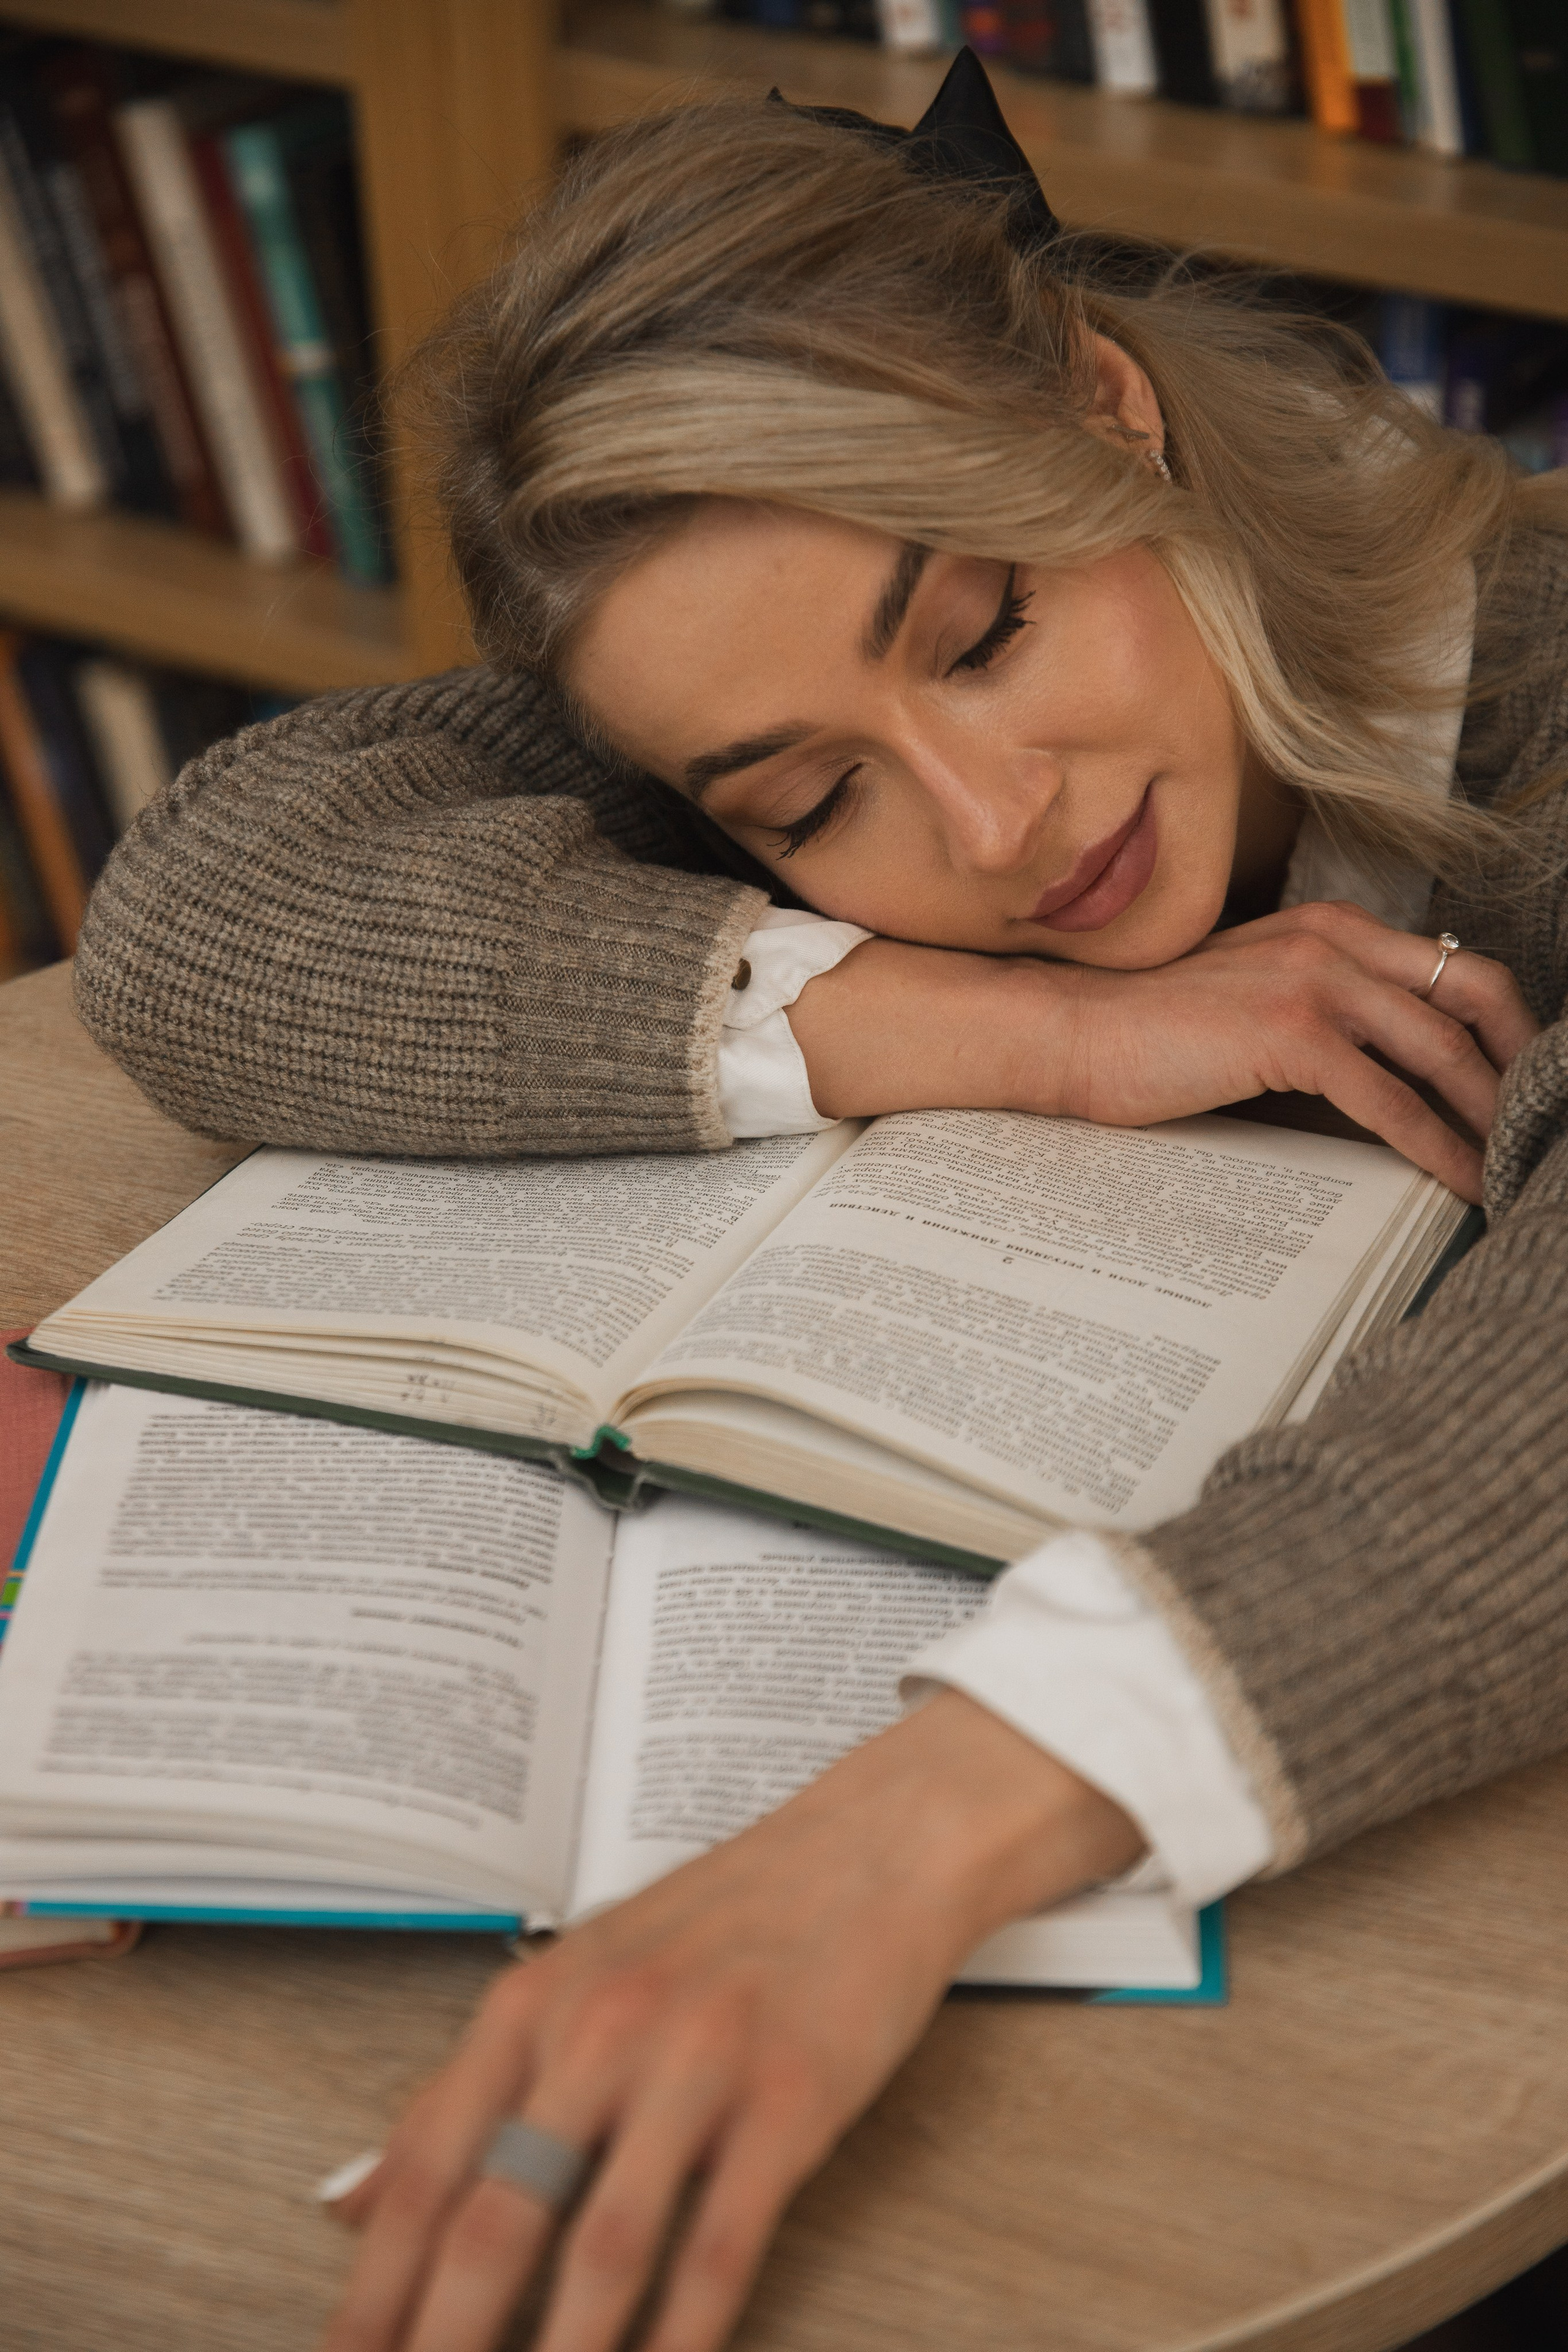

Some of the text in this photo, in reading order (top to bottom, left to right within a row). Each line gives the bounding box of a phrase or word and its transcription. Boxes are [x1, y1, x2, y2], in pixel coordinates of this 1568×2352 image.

[920, 1123, 973, 1139] синдром
[967, 1117, 1005, 1134] более
[1041, 1115, 1101, 1133] никакого
[979, 1139, 1007, 1150] этот
[1010, 1132, 1033, 1142] как
[1104, 1131, 1167, 1147] обращает
[940, 1138, 1029, 1168] описываемого
[1012, 1150, 1035, 1159] что
[1039, 1141, 1077, 1155] время
[1102, 1142, 1188, 1165] намерениями
[1194, 1148, 1214, 1158] бы,
[968, 1153, 1026, 1172] желаний
[1014, 1123, 1343, 1204] деть, наблюдая ориентировочные реакции таких
[1044, 1157, 1091, 1175] думать,
[1218, 1155, 1276, 1169] казалось
[903, 1114, 1323, 1227] жает нарушение всех форм поведения. Как показывает опыт,
[1006, 1170, 1030, 1180] или
[1120, 1163, 1207, 1187] деятельности,
[1202, 1165, 1270, 1182] связанные
[1298, 1171, 1354, 1186] вопросы
[1031, 1171, 1084, 1190] никаких
[1097, 1175, 1160, 1195] неверным
[1033, 1178, 1119, 1206] гипертензией
[1089, 1189, 1148, 1208] выражая
[1107, 1189, 1142, 1202] этого
[1210, 1186, 1299, 1208] сознательной
[1039, 1193, 1120, 1218] массивными
[1169, 1193, 1217, 1209] однако,
[1121, 1205, 1166, 1218] общей
[1226, 1207, 1246, 1217] бы,
[1305, 1207, 1332, 1216] ции
[1126, 1216, 1187, 1235] наиболее
[1189, 1212, 1245, 1228] выводит
[1252, 1215, 1290, 1227] Было
[1224, 1226, 1285, 1243] пассивно
[1272, 1231, 1312, 1245] голод
[1289, 1230, 1316, 1239] как
[1204, 1237, 1265, 1257] Больные
[1243, 1236, 1303, 1254] нениями
[1000, 1256, 1015, 1264] 2
